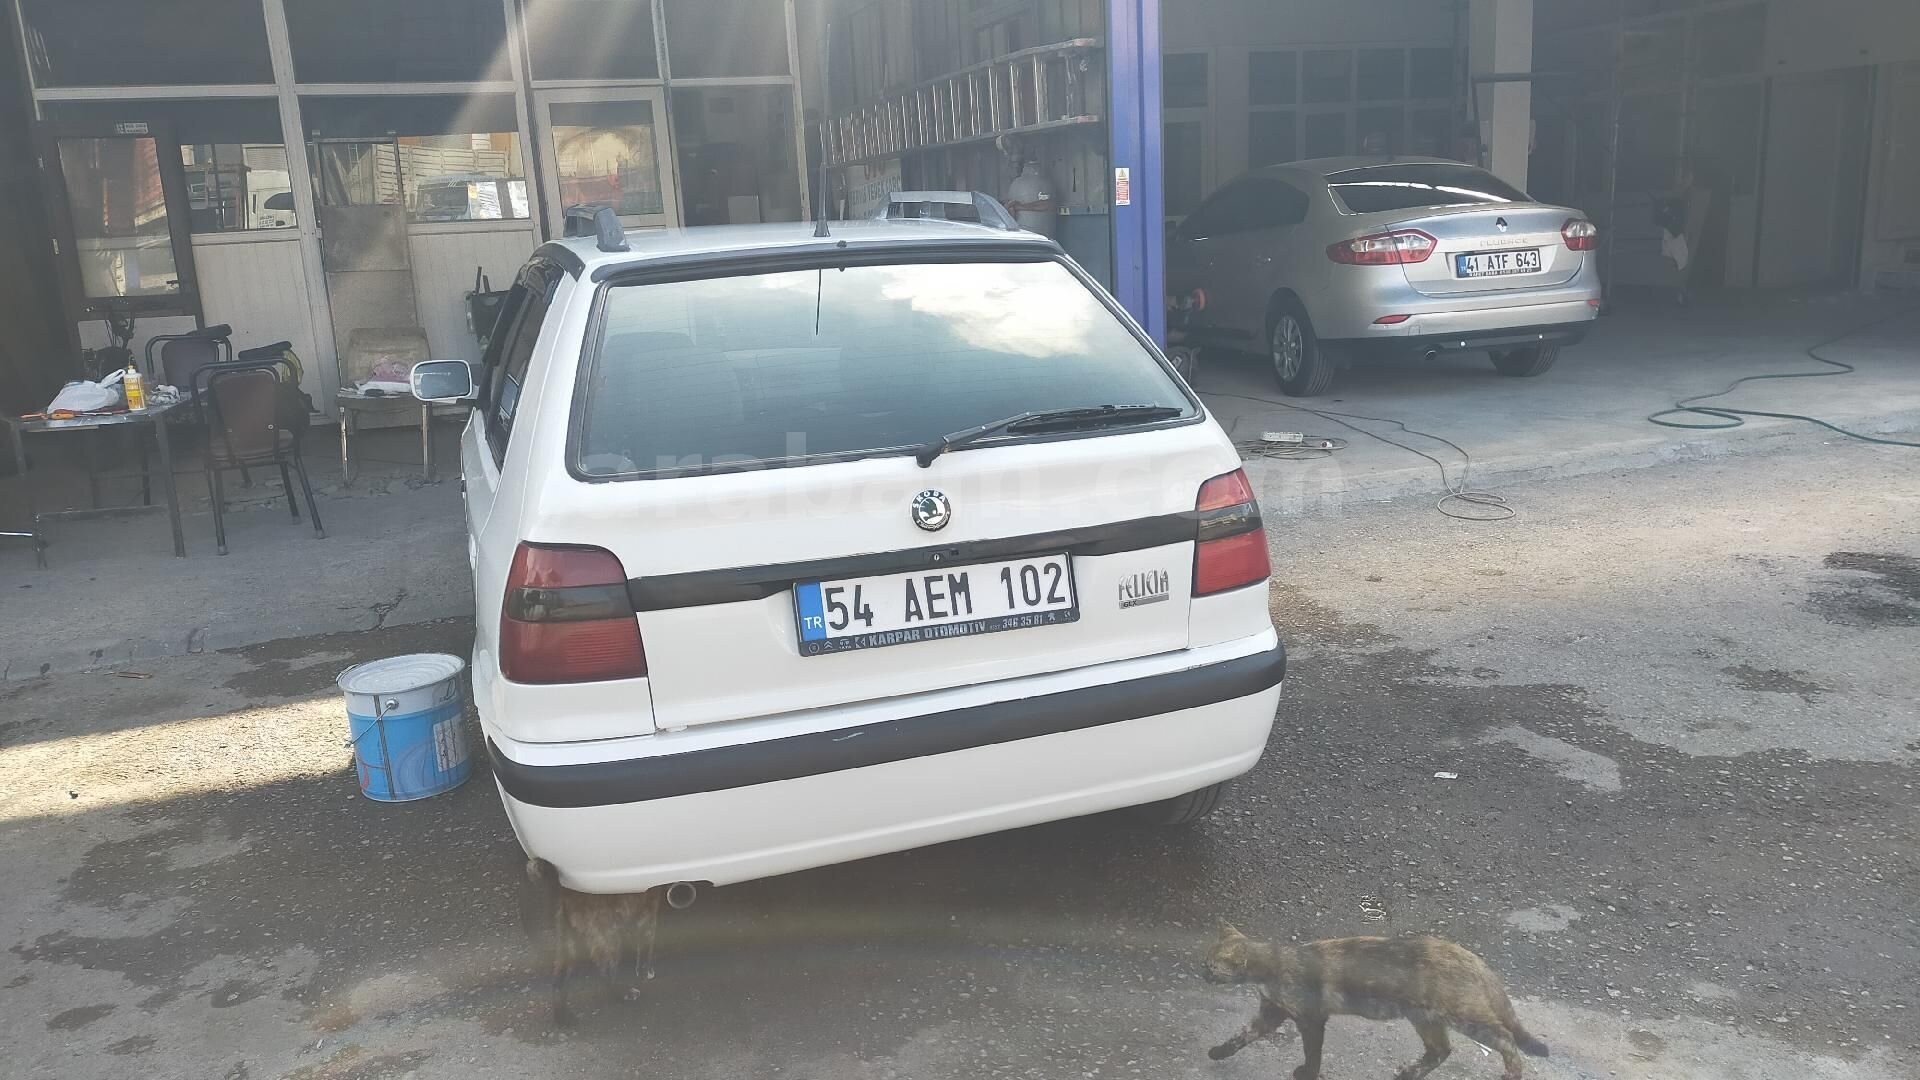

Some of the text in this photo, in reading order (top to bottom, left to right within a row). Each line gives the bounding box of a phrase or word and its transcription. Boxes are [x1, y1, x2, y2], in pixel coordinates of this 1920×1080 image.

[1467, 257, 1479, 271] 41
[1487, 254, 1509, 270] ATF
[1516, 252, 1537, 268] 643
[824, 562, 1066, 631] 54 AEM 102
[1118, 568, 1170, 601] FELICIA
[803, 616, 822, 630] TR
[868, 629, 920, 647] KARPAR
[1002, 617, 1018, 629] 346
[1020, 615, 1032, 626] 35
